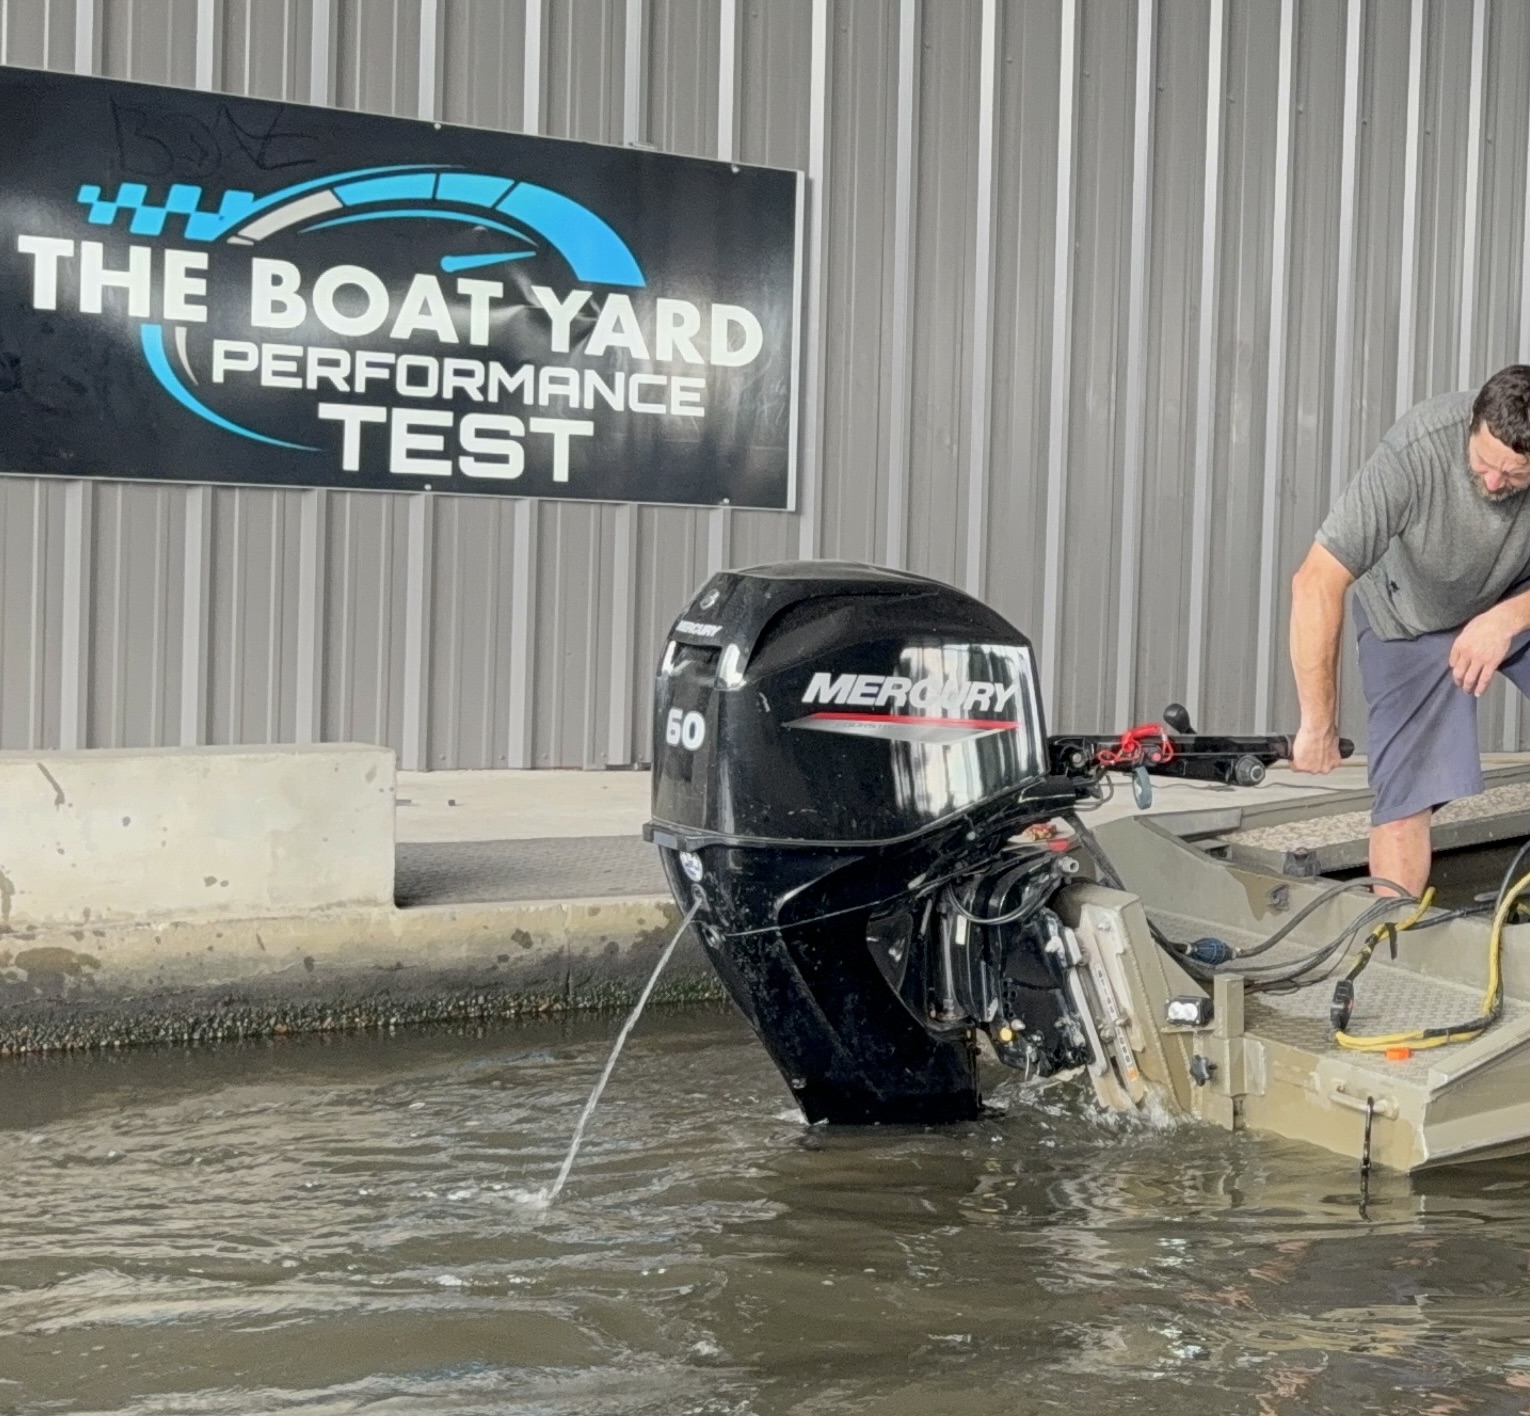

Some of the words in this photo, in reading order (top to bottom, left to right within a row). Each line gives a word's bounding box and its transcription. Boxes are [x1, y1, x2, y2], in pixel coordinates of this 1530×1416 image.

[18, 235, 209, 323] THE
[251, 257, 504, 347] BOAT
[531, 284, 763, 368] YARD
[212, 339, 706, 417] PERFORMANCE
[318, 402, 595, 483] TEST
[676, 620, 723, 637] MERCURY
[802, 672, 1020, 713] MERCURY
[666, 707, 705, 751] 60
